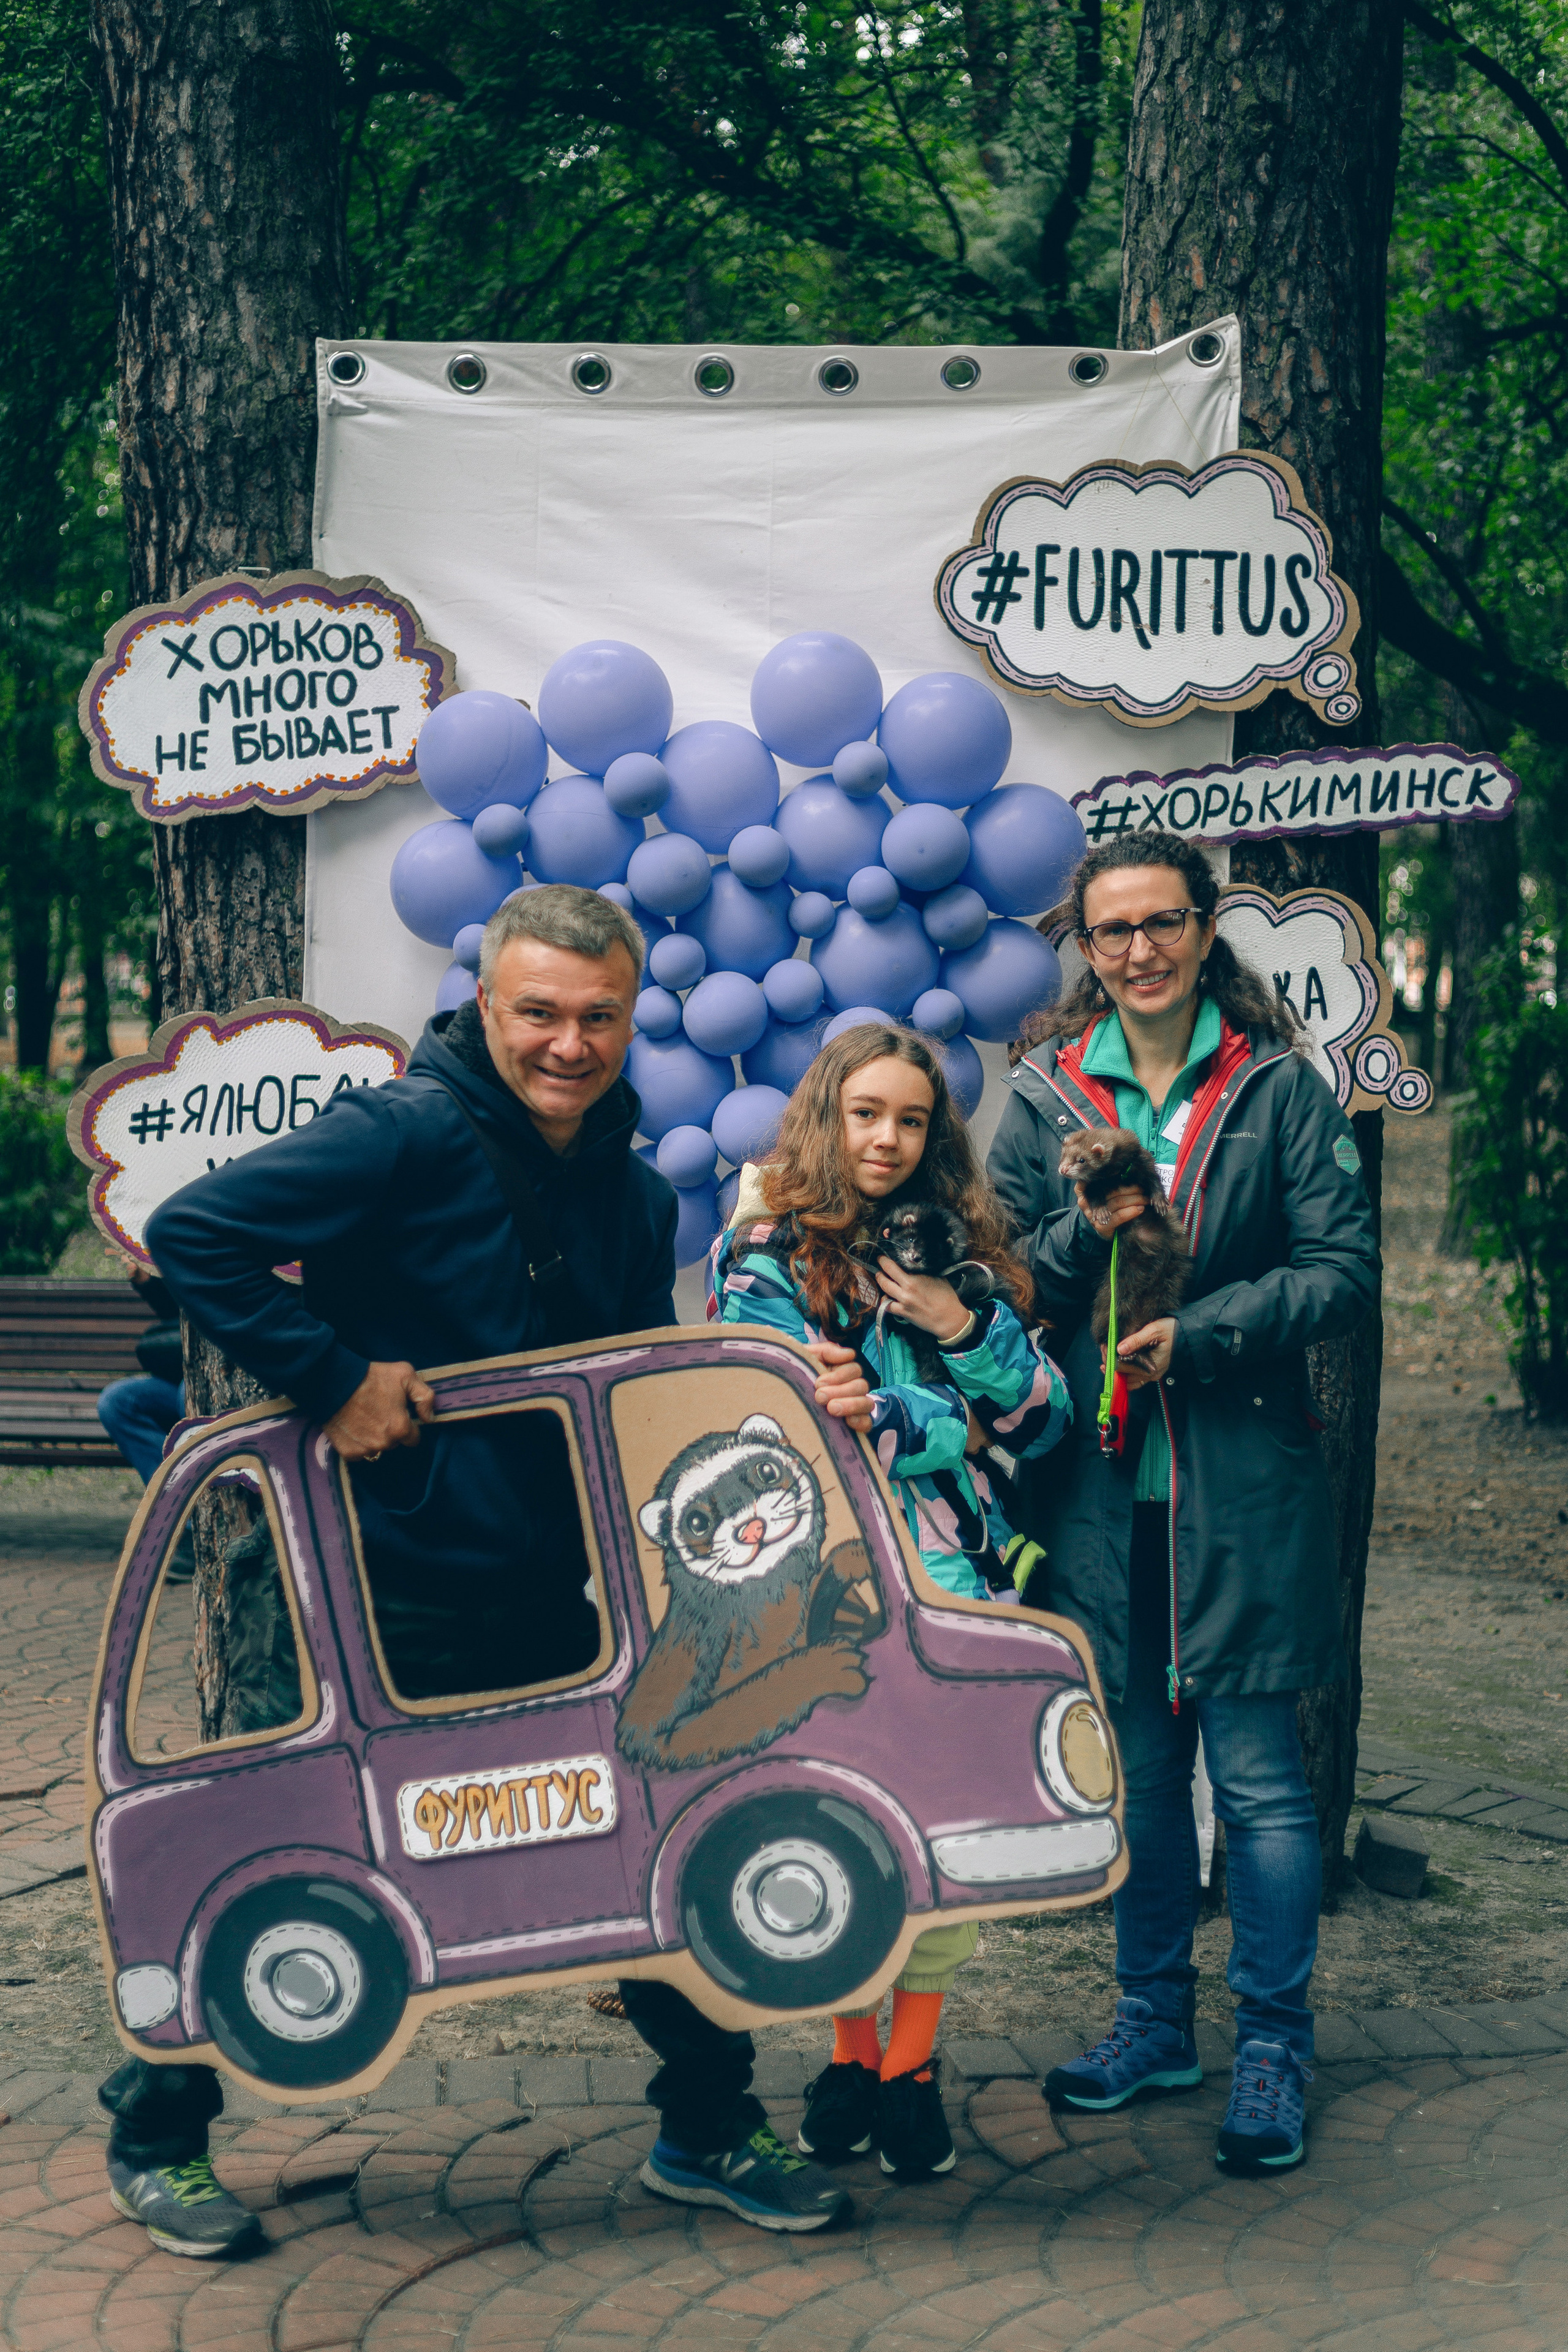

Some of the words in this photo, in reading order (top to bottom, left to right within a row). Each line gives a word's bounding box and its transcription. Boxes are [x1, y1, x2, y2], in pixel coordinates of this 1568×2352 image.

[971, 544, 1312, 649] #FURITTUS
[161, 618, 383, 679] ХОРЬКОВ
[199, 668, 358, 724] МНОГО
[156, 729, 209, 774] НЕ
[233, 705, 400, 765] БЫВАЕТ
[1086, 767, 1497, 842] #ХОРЬКИМИНСК
[129, 1073, 370, 1144] #ЯЛЮБ
[414, 1768, 603, 1850] ФУРИТТУС
